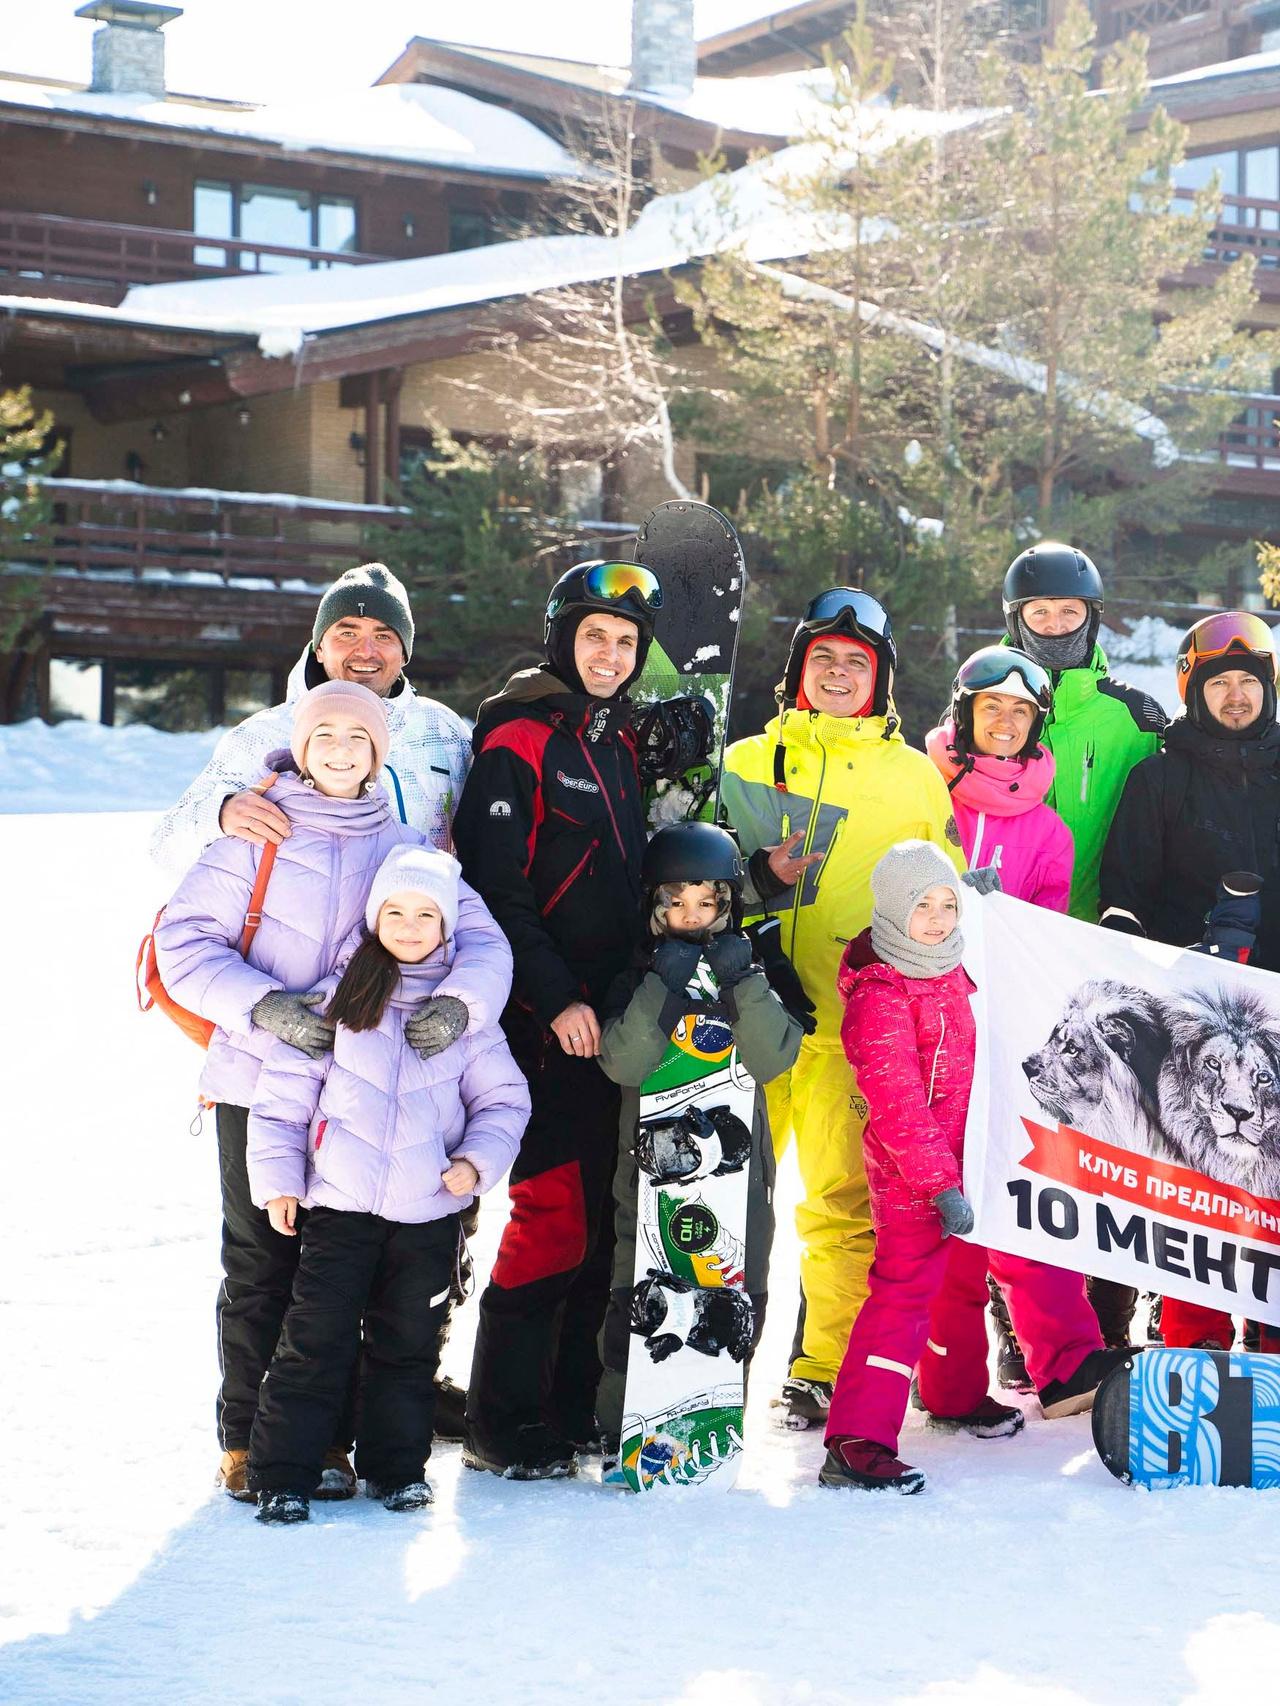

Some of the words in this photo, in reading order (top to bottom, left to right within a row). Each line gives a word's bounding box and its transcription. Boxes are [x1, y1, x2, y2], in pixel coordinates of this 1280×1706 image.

[1078, 1149, 1138, 1188] КЛУБ
[680, 1216, 693, 1242] 110
[1007, 1179, 1079, 1240] 10
